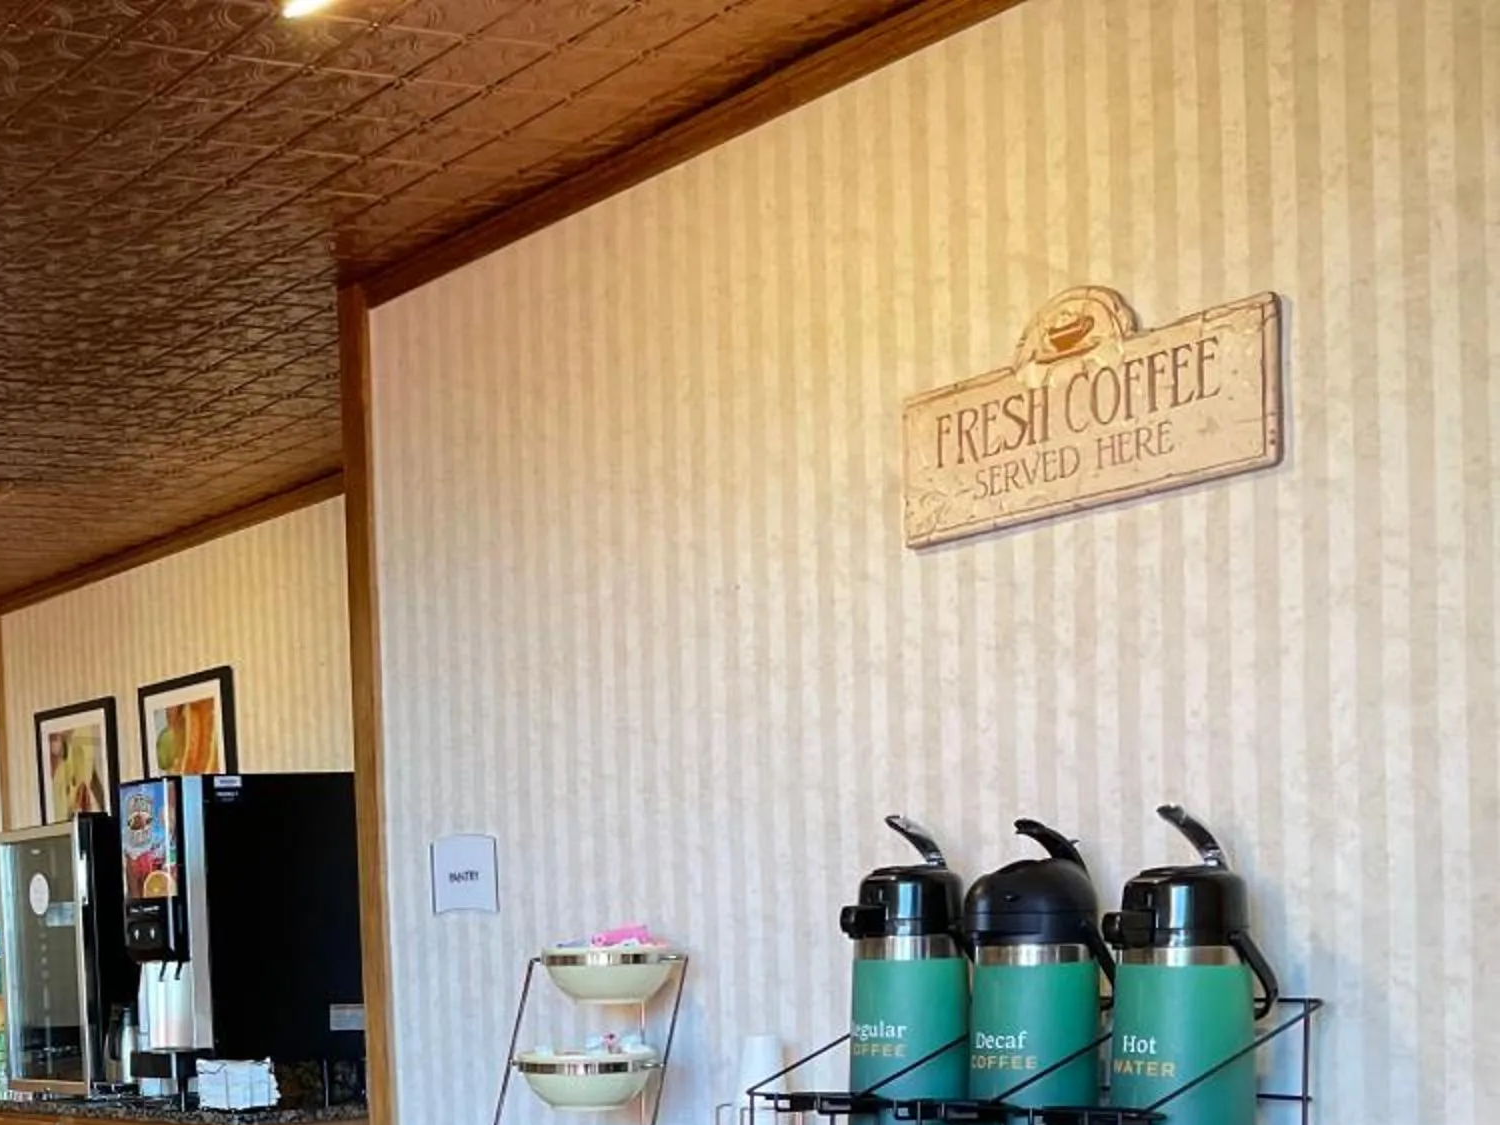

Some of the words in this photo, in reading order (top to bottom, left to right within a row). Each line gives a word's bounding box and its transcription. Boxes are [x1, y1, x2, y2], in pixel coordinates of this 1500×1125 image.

[936, 384, 1049, 468] FRESH
[1065, 335, 1221, 432] COFFEE
[973, 445, 1080, 500] SERVED
[1097, 420, 1175, 470] HERE
[975, 1030, 1028, 1050] Decaf
[1123, 1035, 1157, 1054] Hot
[852, 1044, 907, 1057] OFFEE
[972, 1055, 1037, 1070] COFFEE
[1113, 1060, 1176, 1077] WATER
